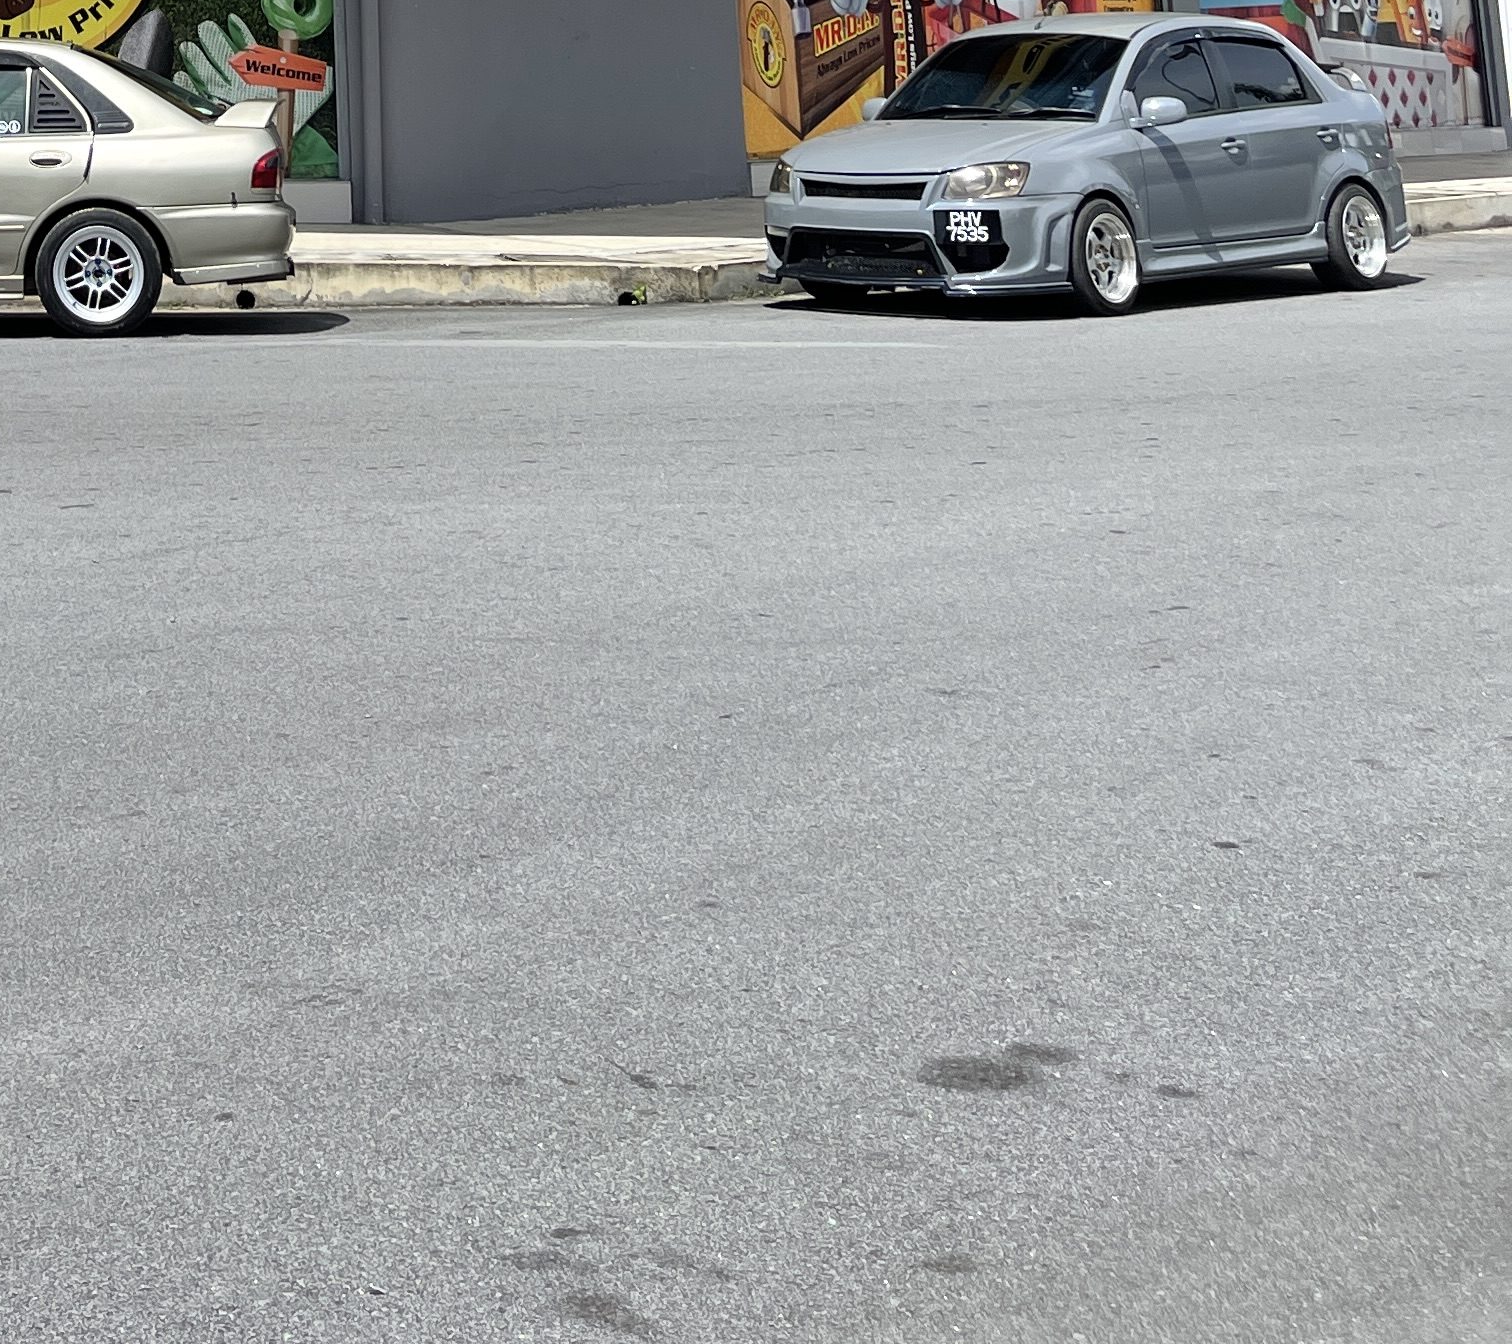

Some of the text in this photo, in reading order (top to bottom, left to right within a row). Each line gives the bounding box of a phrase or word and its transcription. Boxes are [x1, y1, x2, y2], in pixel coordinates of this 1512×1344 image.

[245, 58, 322, 84] Welcome
[949, 211, 981, 227] PHV
[946, 226, 989, 242] 7535
